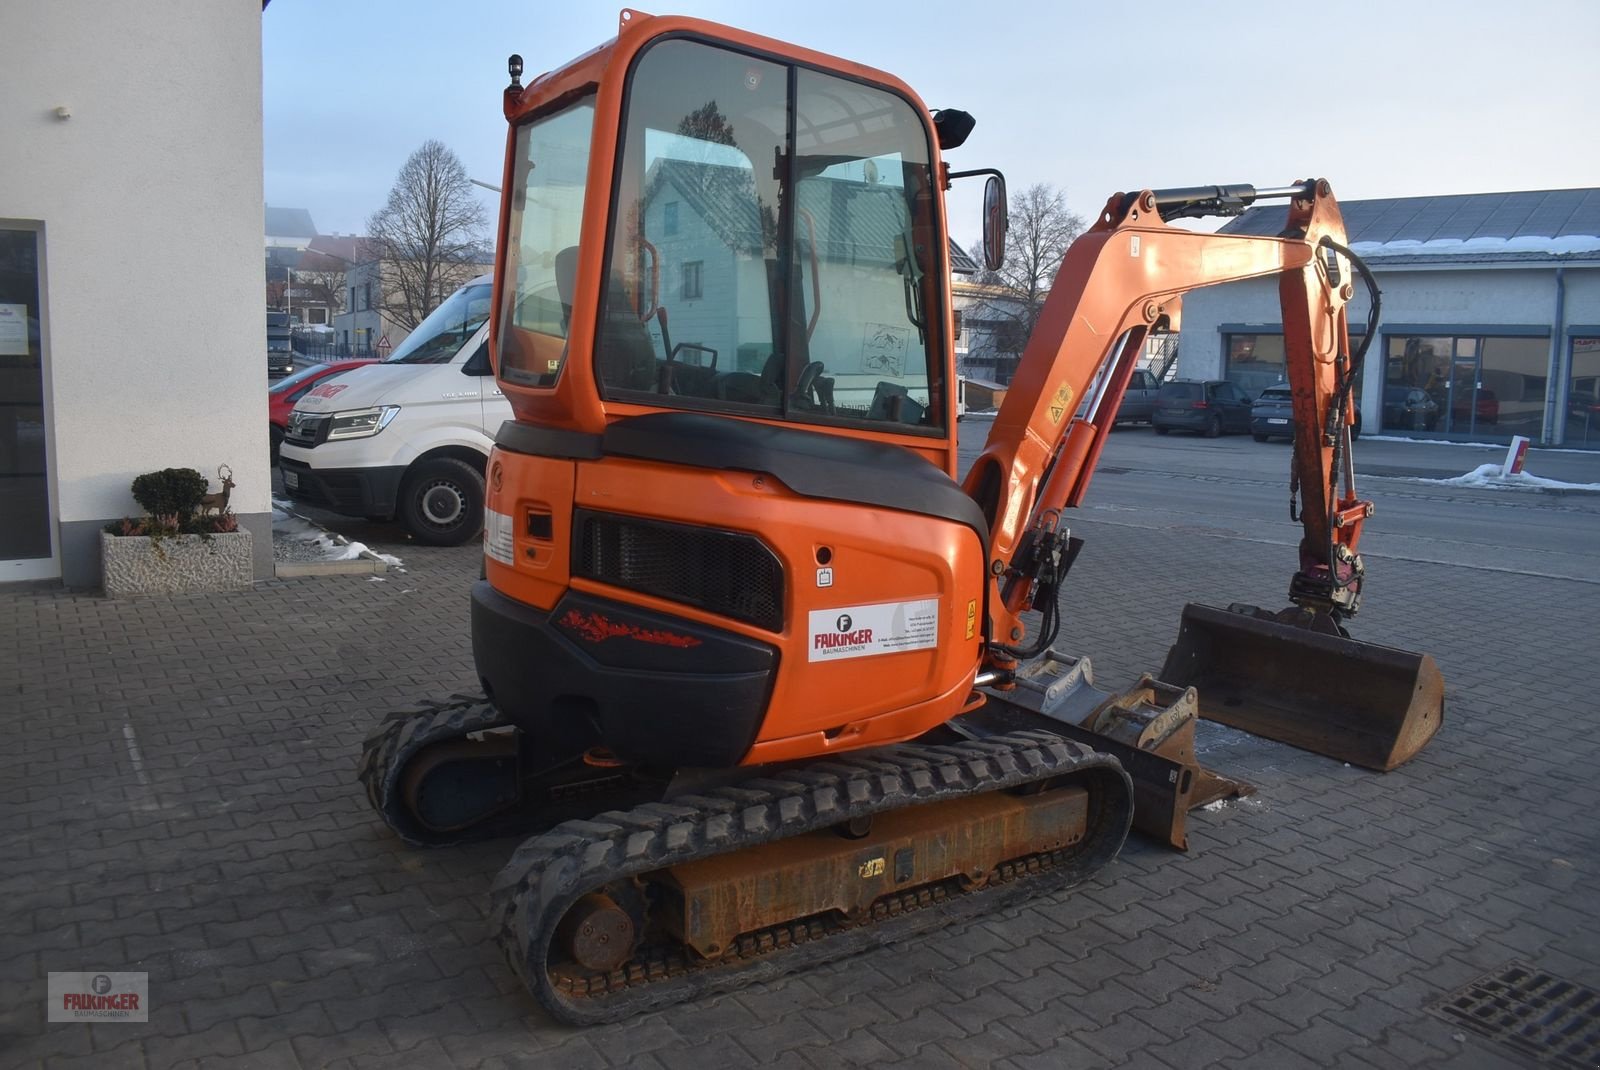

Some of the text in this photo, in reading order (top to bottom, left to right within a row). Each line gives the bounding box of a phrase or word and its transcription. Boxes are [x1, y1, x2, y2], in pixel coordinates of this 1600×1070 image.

[839, 616, 849, 631] F
[814, 629, 873, 649] FALKINGER
[822, 645, 866, 655] BAUMASCHINEN
